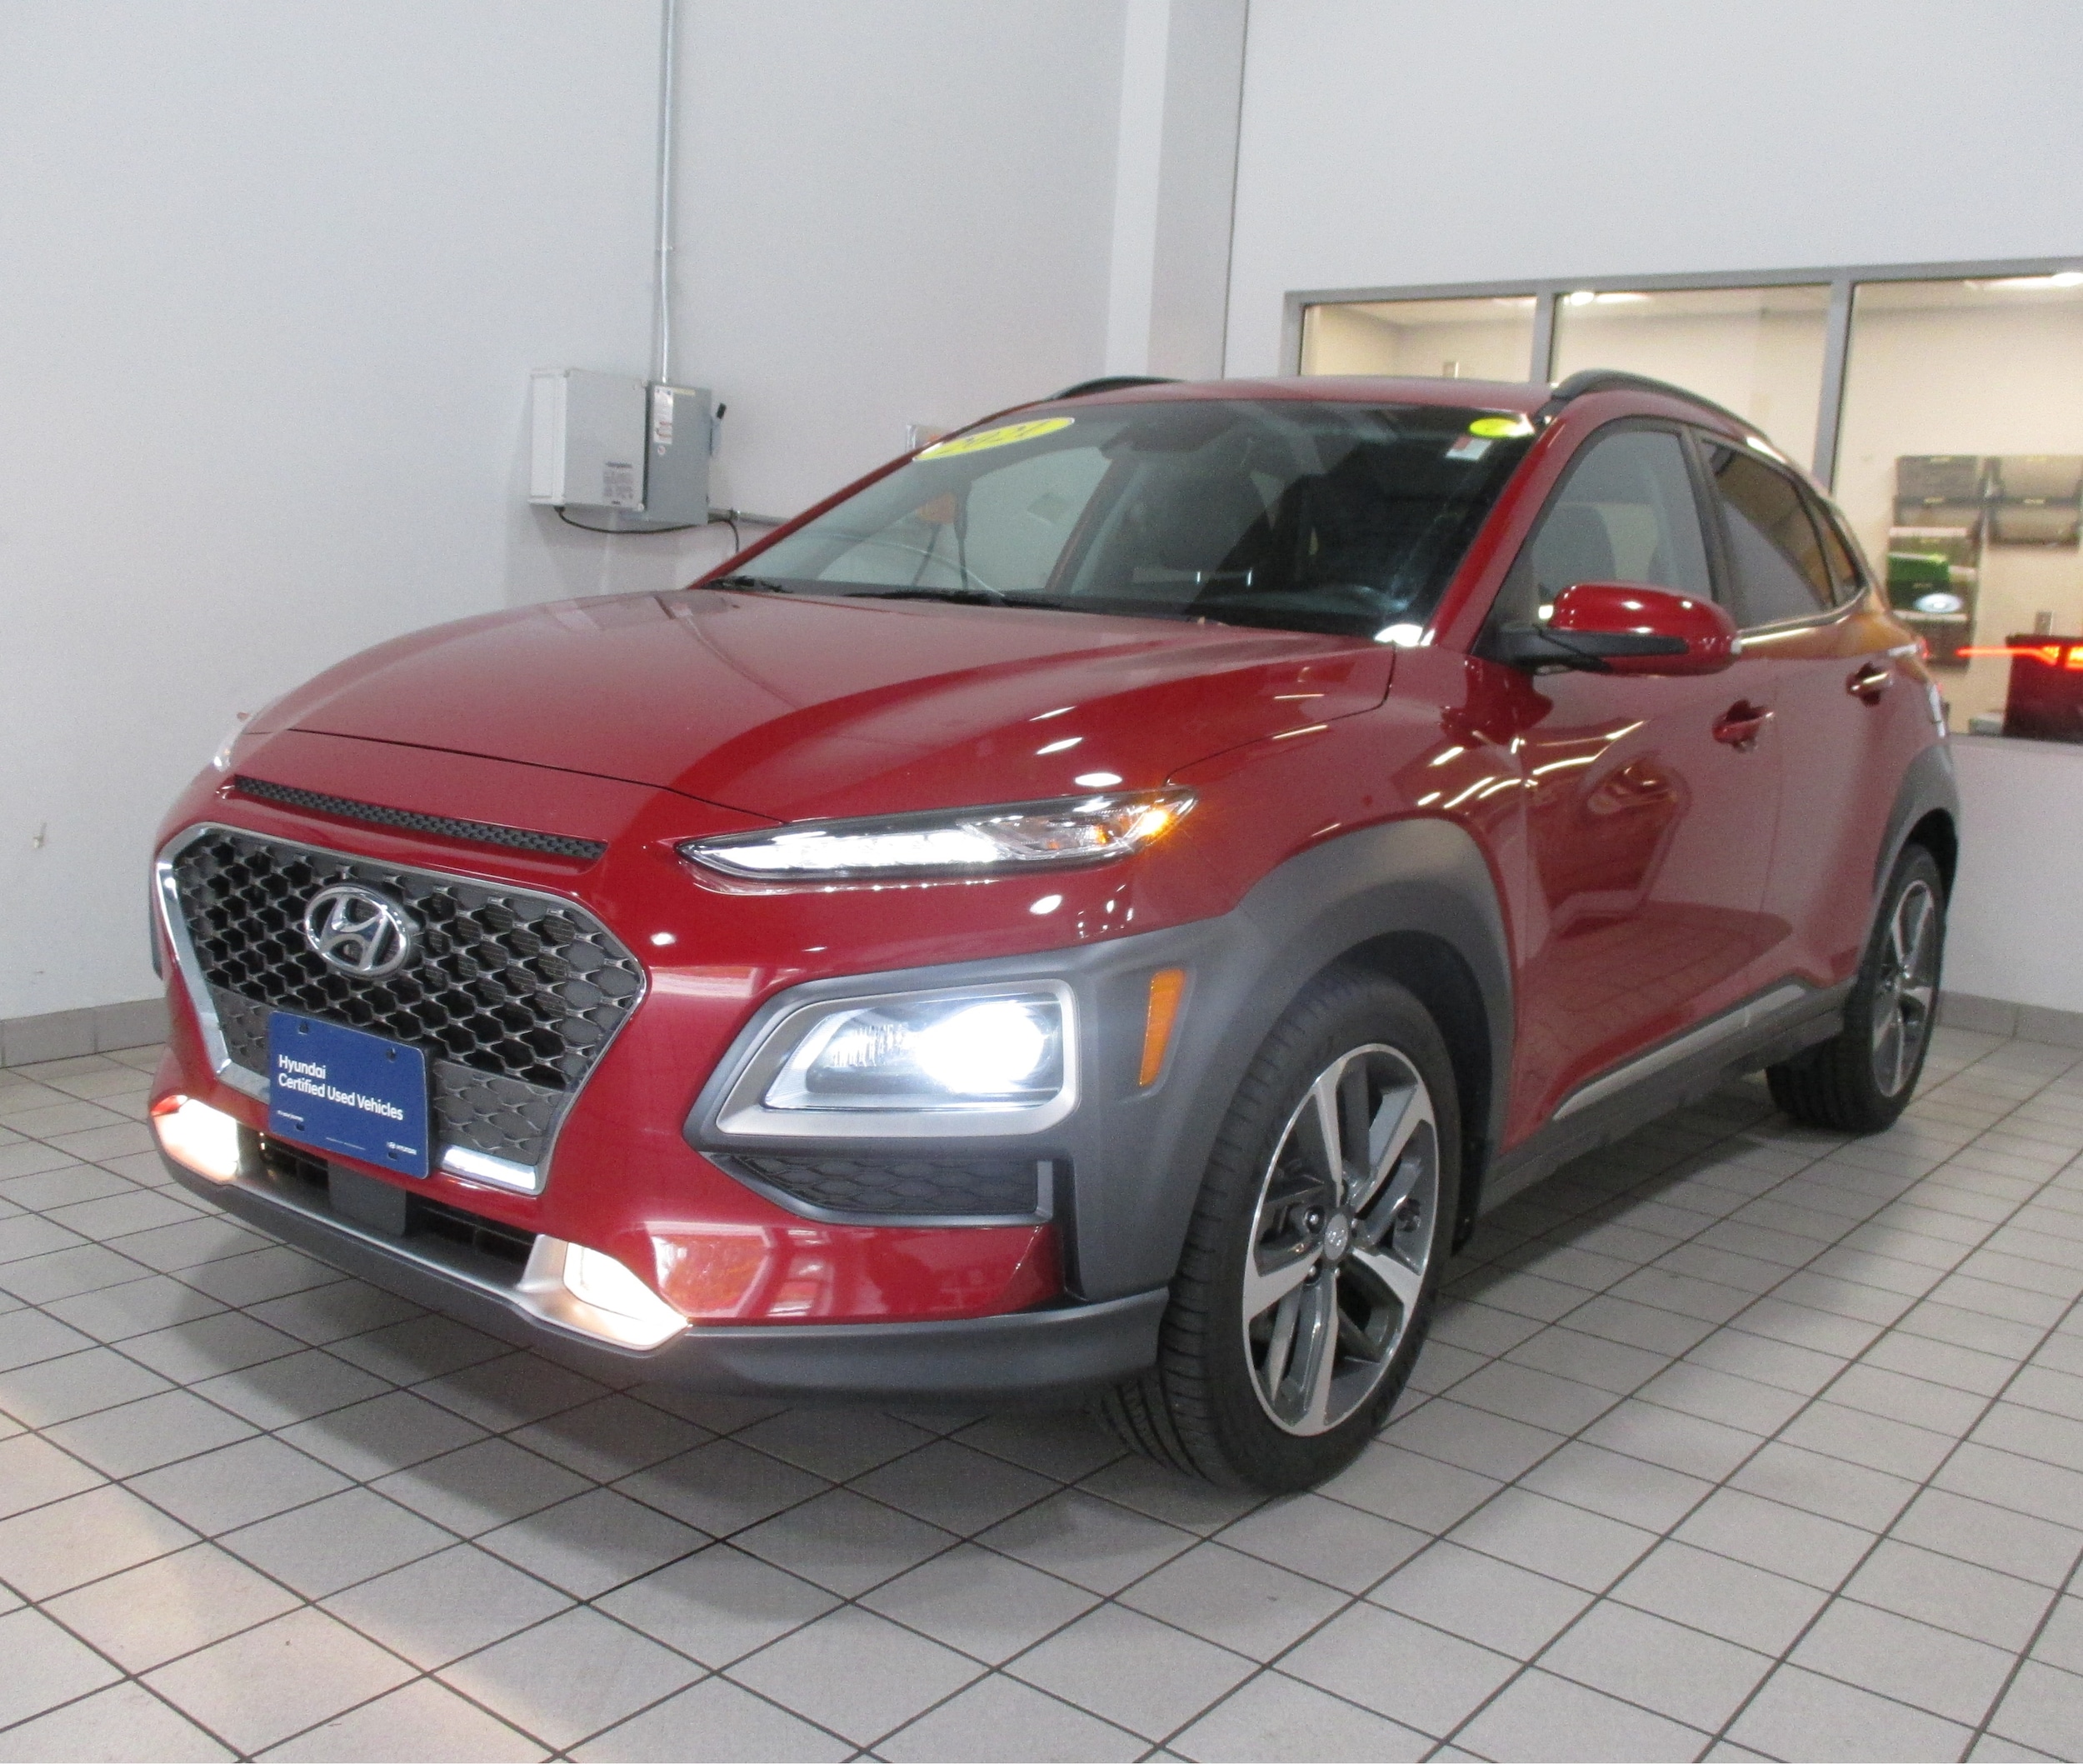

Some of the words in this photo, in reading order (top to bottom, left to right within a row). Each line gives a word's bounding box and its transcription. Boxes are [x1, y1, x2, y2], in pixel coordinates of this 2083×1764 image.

[278, 1054, 327, 1079] Hyundai
[278, 1073, 326, 1097] Certified
[327, 1087, 356, 1107] Used
[357, 1093, 404, 1121] Vehicles
